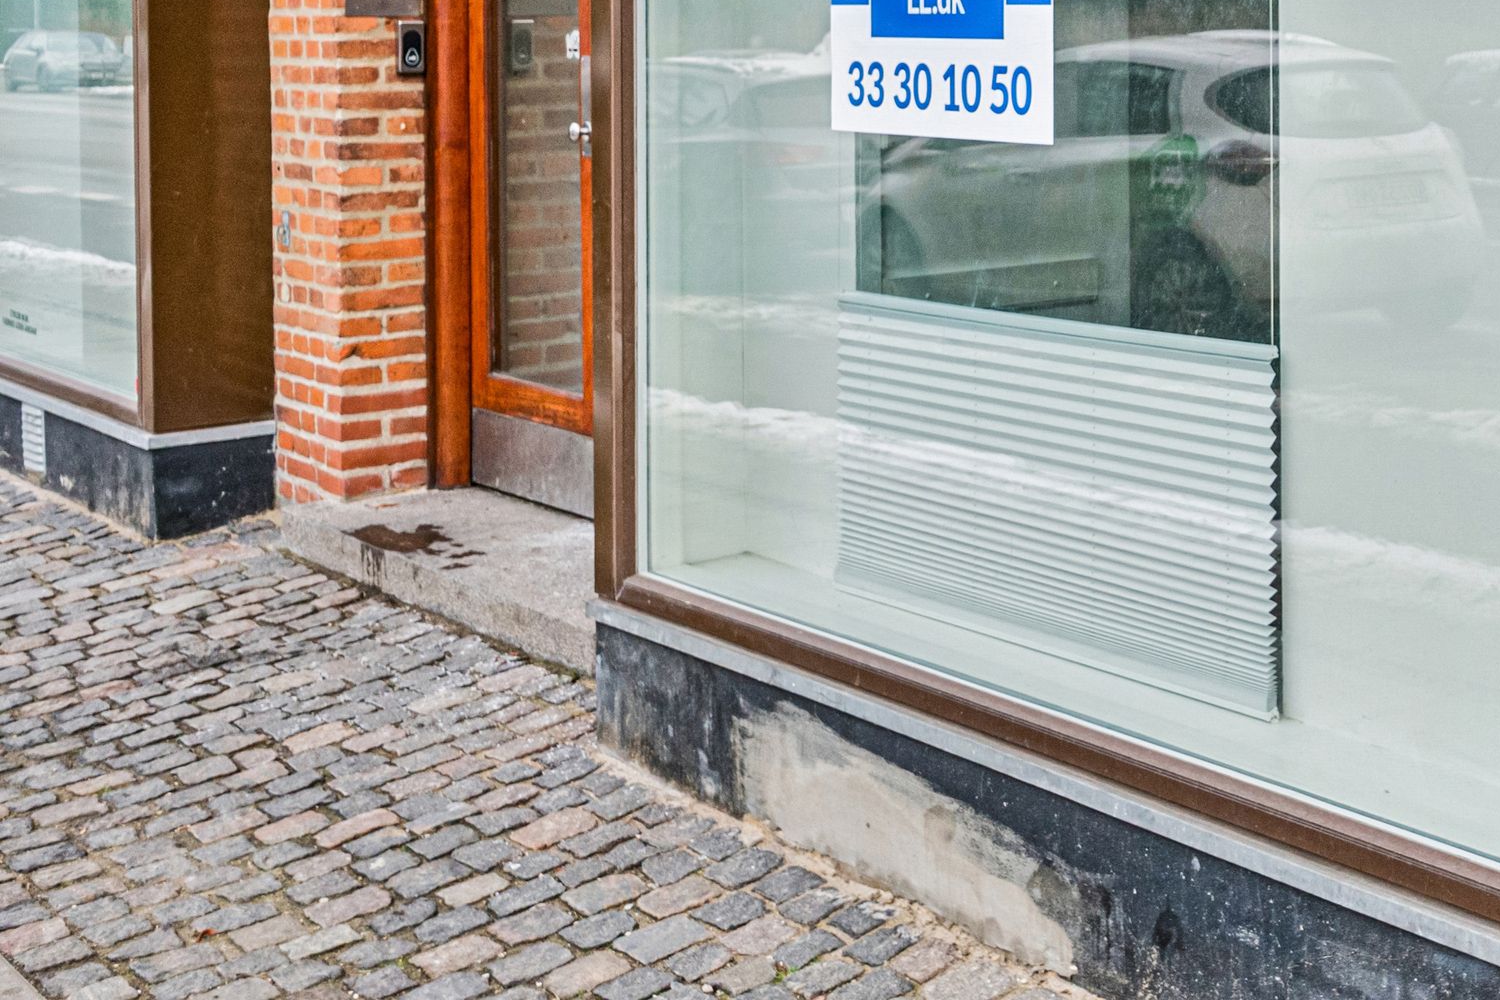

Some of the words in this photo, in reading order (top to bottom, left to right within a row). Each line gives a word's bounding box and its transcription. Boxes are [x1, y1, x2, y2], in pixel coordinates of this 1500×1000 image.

[848, 60, 885, 108] 33
[893, 62, 933, 111] 30
[942, 64, 982, 114] 10
[989, 65, 1033, 116] 50
